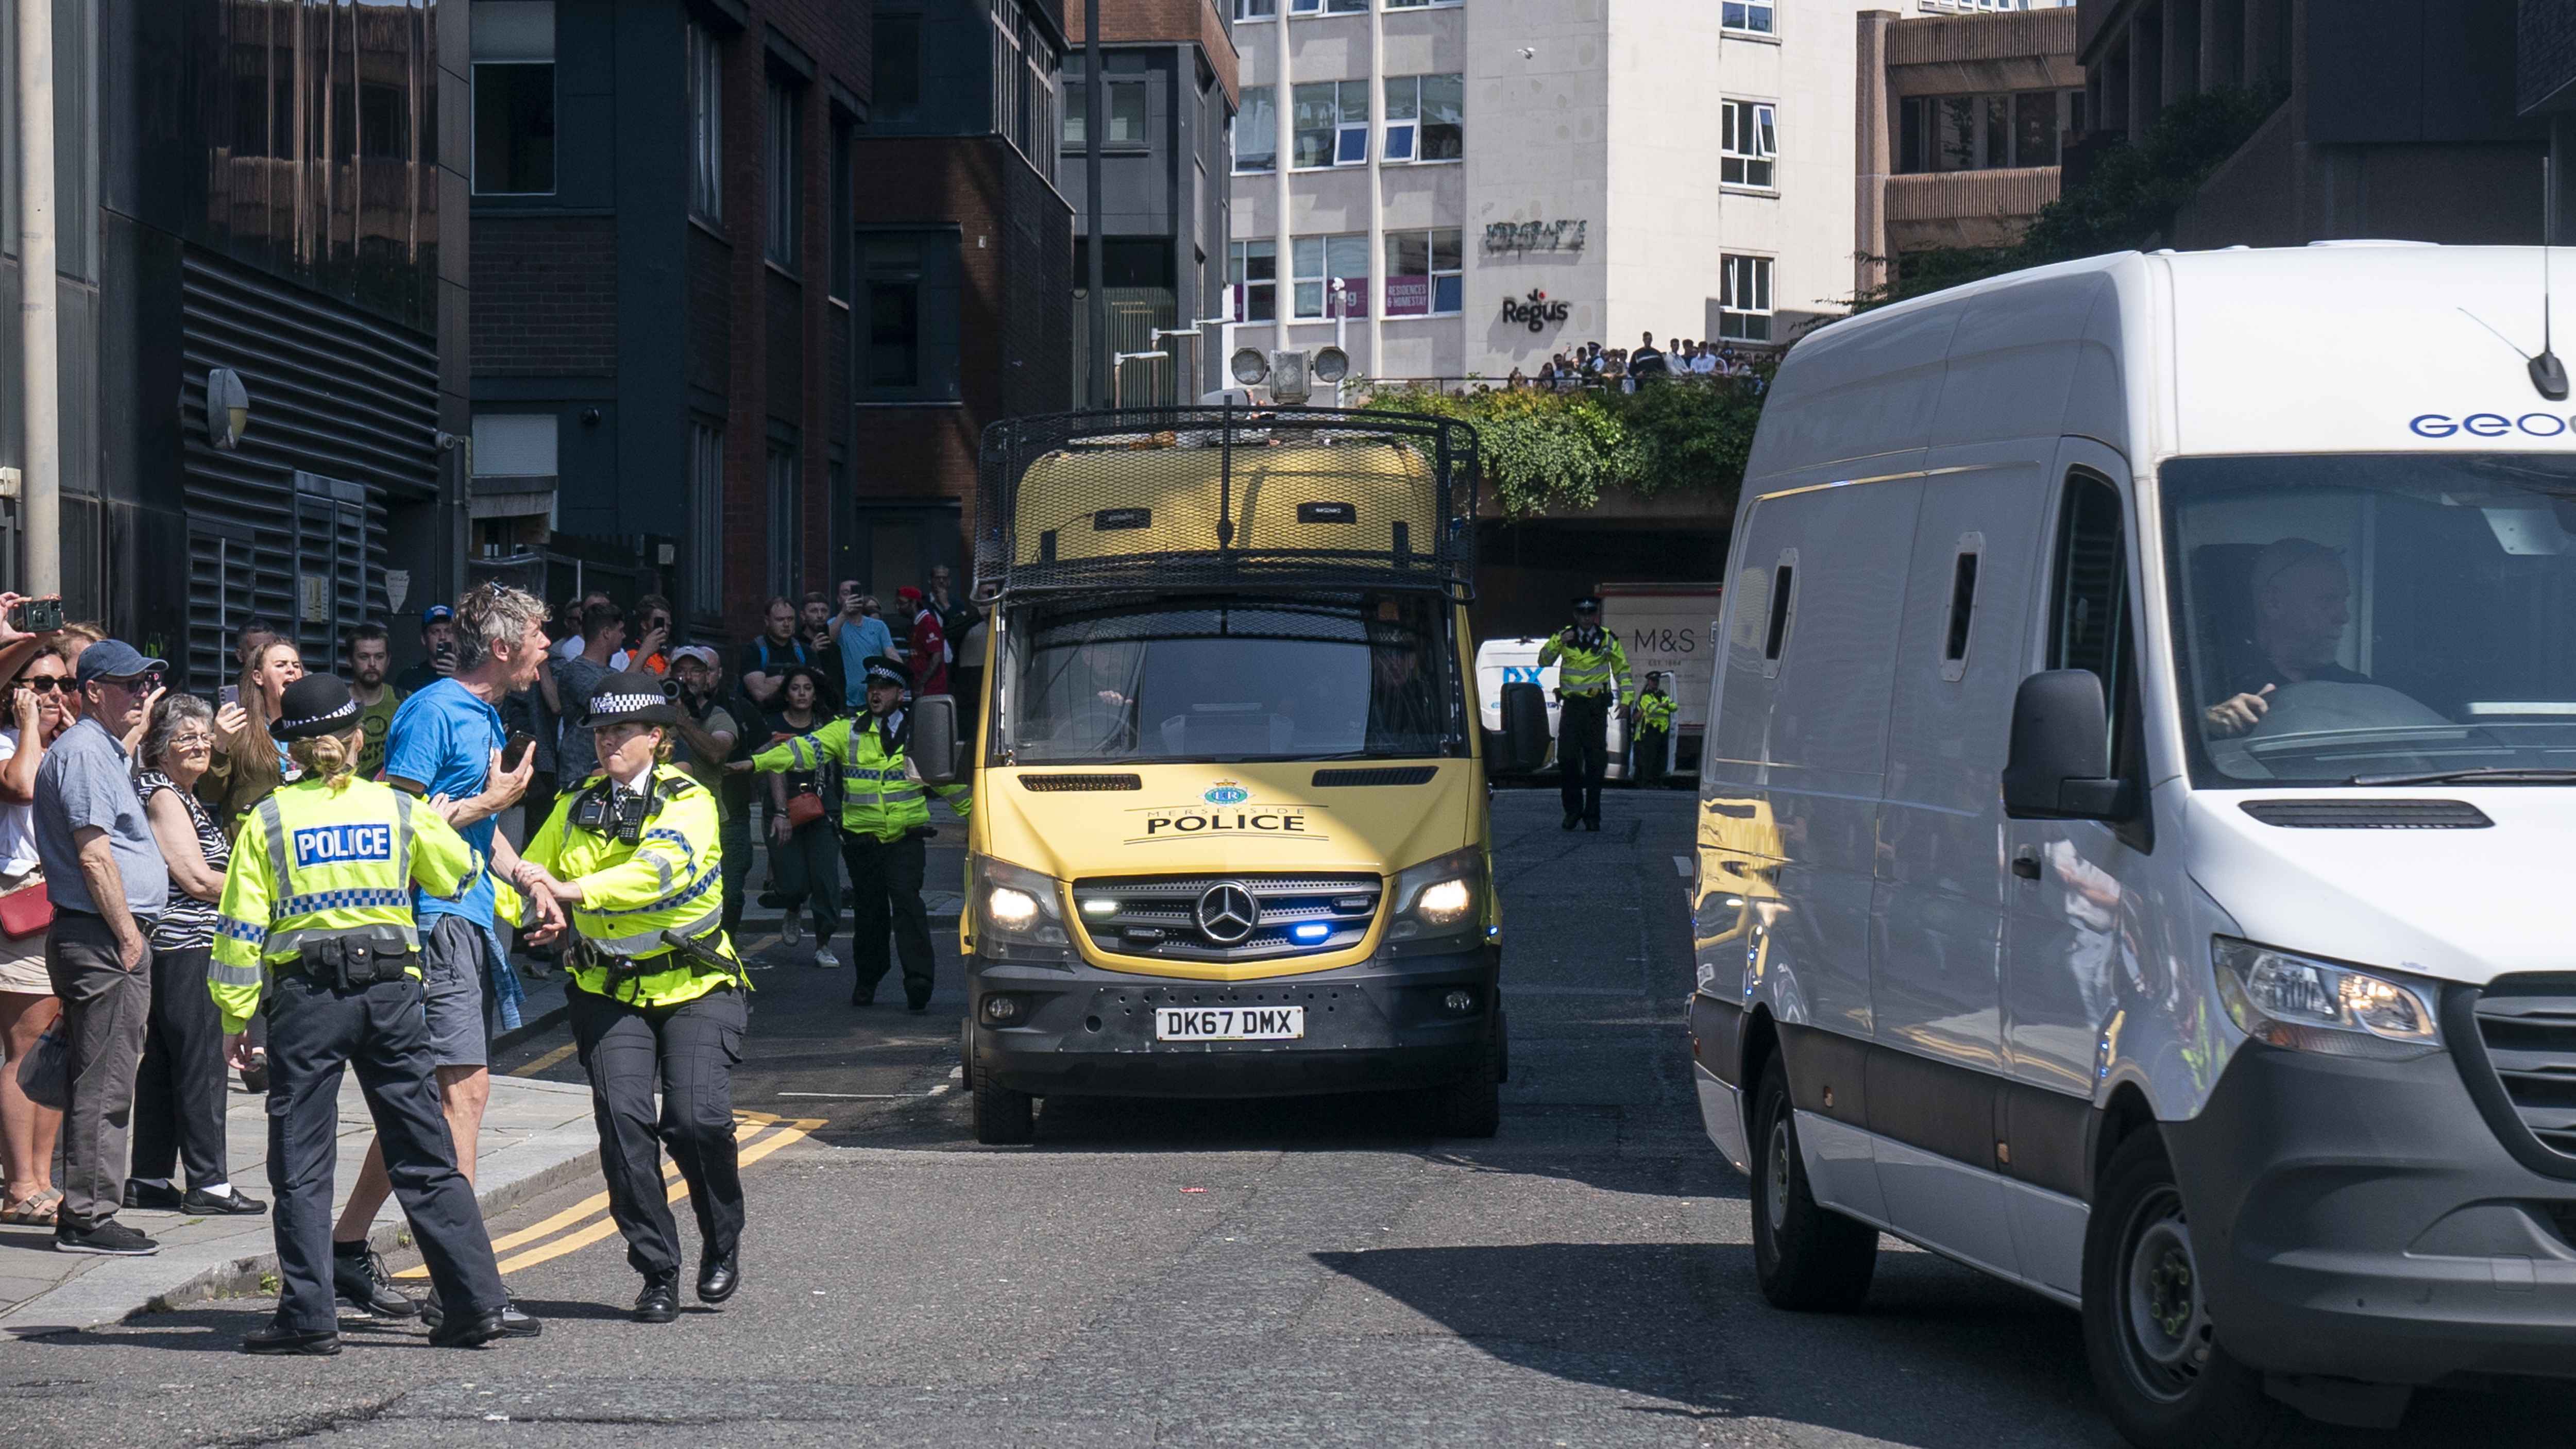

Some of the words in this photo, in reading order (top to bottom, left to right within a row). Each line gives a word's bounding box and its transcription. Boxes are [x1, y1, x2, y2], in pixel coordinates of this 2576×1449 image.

[1388, 284, 1427, 295] RESIDENCES
[1393, 296, 1427, 307] HOMESTAY
[1502, 298, 1571, 333] Regus
[1634, 628, 1696, 653] M&S
[1147, 808, 1305, 817] MERSEYSIDE
[1147, 815, 1304, 834] POLICE
[297, 827, 387, 861] POLICE
[1167, 1012, 1233, 1035] DK67
[1242, 1010, 1292, 1034] DMX
